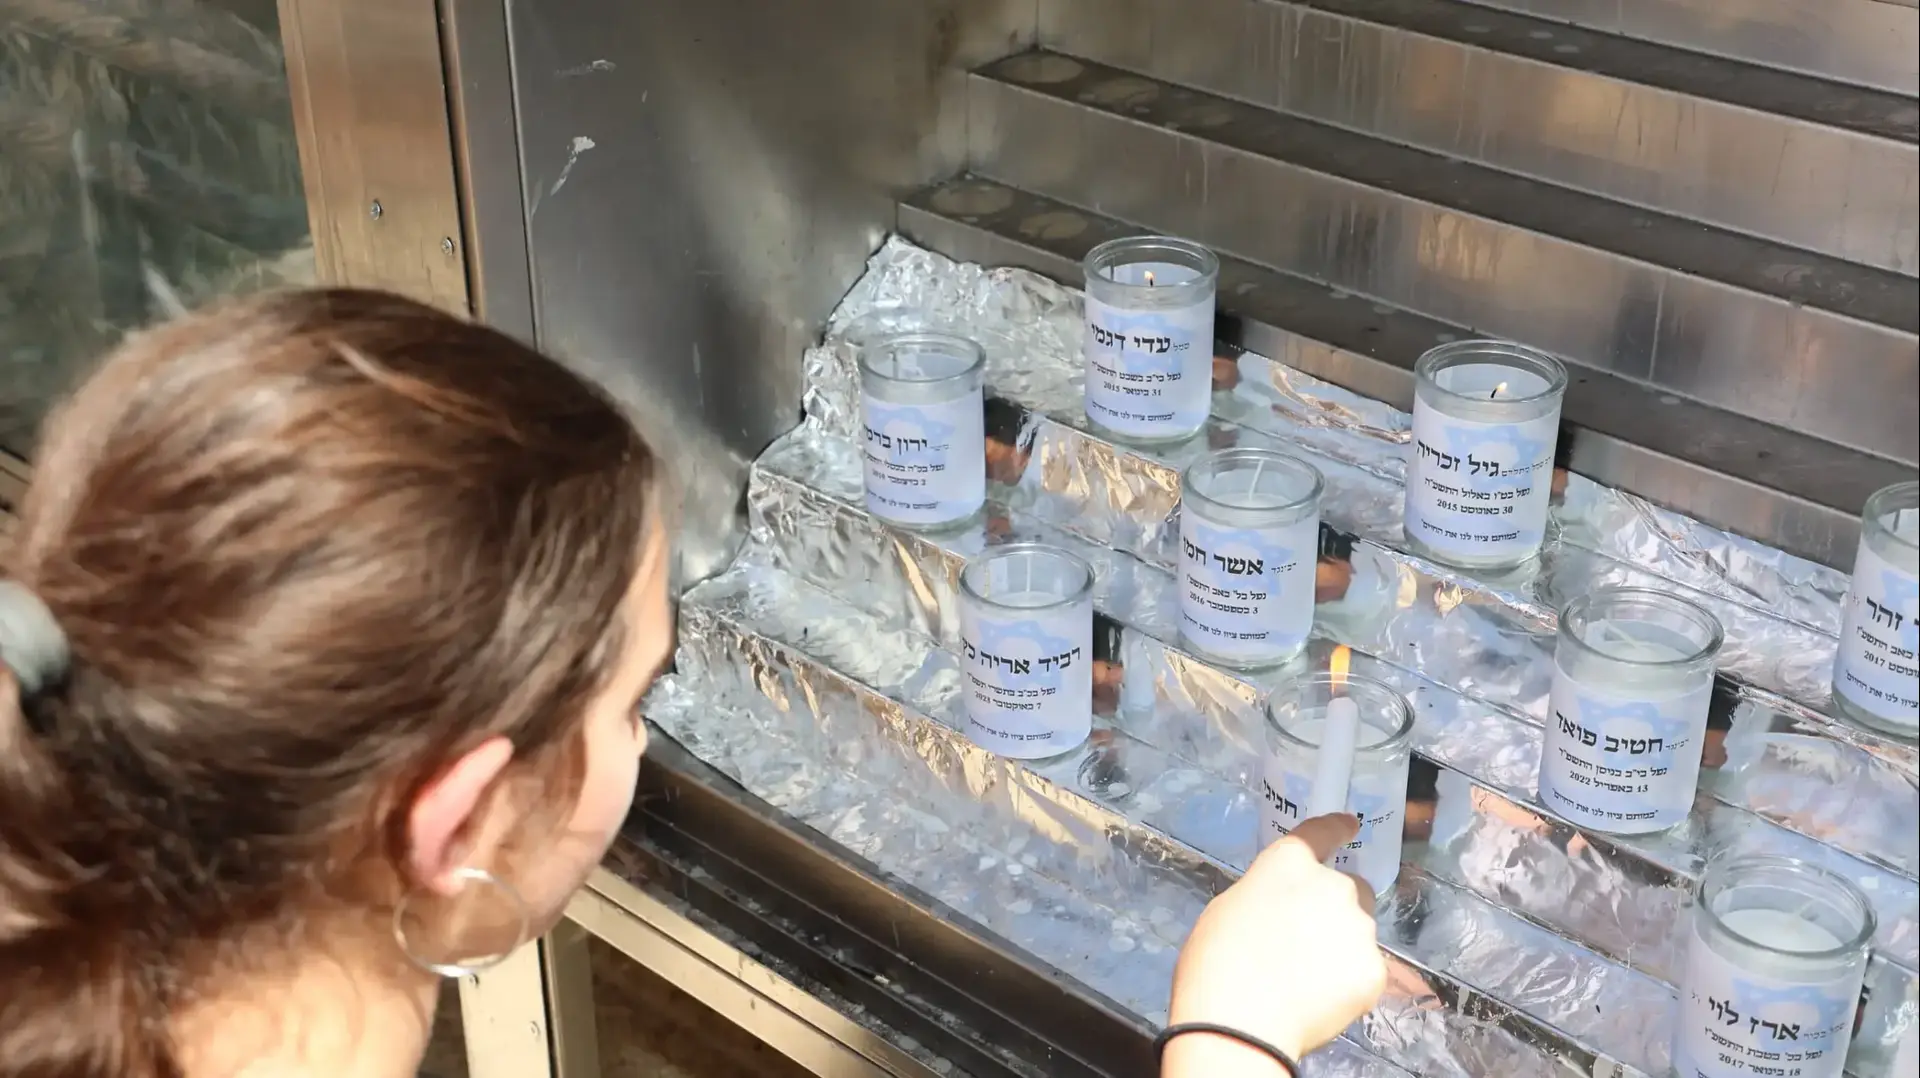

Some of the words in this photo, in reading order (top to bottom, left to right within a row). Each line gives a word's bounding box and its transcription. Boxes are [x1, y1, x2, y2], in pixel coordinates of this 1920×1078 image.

[1091, 323, 1126, 350] דגמי
[1133, 336, 1170, 353] עדי
[1167, 372, 1181, 381] נפל
[1103, 381, 1120, 392] 2015
[897, 437, 927, 455] ירון
[1416, 440, 1460, 472] זכריה
[930, 464, 945, 472] נפל
[1467, 454, 1500, 477] גיל
[1462, 487, 1490, 500] באלול
[1516, 487, 1530, 497] נפל
[1437, 499, 1457, 511] 2015
[1461, 505, 1499, 515] באוגוסט
[1502, 506, 1513, 514] 30
[1445, 530, 1457, 539] את
[1460, 532, 1472, 540] לנו
[1213, 553, 1264, 575] אשר
[1190, 591, 1204, 605] 2016
[1212, 588, 1230, 598] באב
[1250, 591, 1266, 600] נפל
[1206, 600, 1250, 614] בספטמבר
[1866, 596, 1903, 631] זהר
[1864, 650, 1885, 667] 2017
[1891, 645, 1914, 659] באב
[980, 651, 1030, 674] אריה
[988, 683, 1015, 696] בתשרי
[1040, 687, 1056, 695] נפל
[1869, 686, 1882, 698] את
[975, 691, 991, 703] 2023
[1885, 693, 1898, 703] לנו
[992, 698, 1033, 711] באוקטובר
[1556, 710, 1597, 746] פואד
[1604, 734, 1663, 754] חטיב
[1569, 770, 1591, 785] 2022
[1596, 765, 1621, 777] בניסן
[1625, 770, 1647, 778] בי"ב
[1650, 767, 1667, 776] נפל
[1593, 778, 1633, 792] באפריל
[1263, 777, 1298, 819] חגיגי
[1576, 803, 1589, 813] את
[1591, 809, 1604, 817] לנו
[1708, 996, 1739, 1025] לוי
[1749, 1016, 1801, 1040] ארז
[1747, 1047, 1780, 1060] בטבת
[1805, 1050, 1823, 1060] נפל
[1719, 1053, 1745, 1068] 2017
[1748, 1064, 1785, 1076] בינואר
[1789, 1068, 1801, 1076] 18
